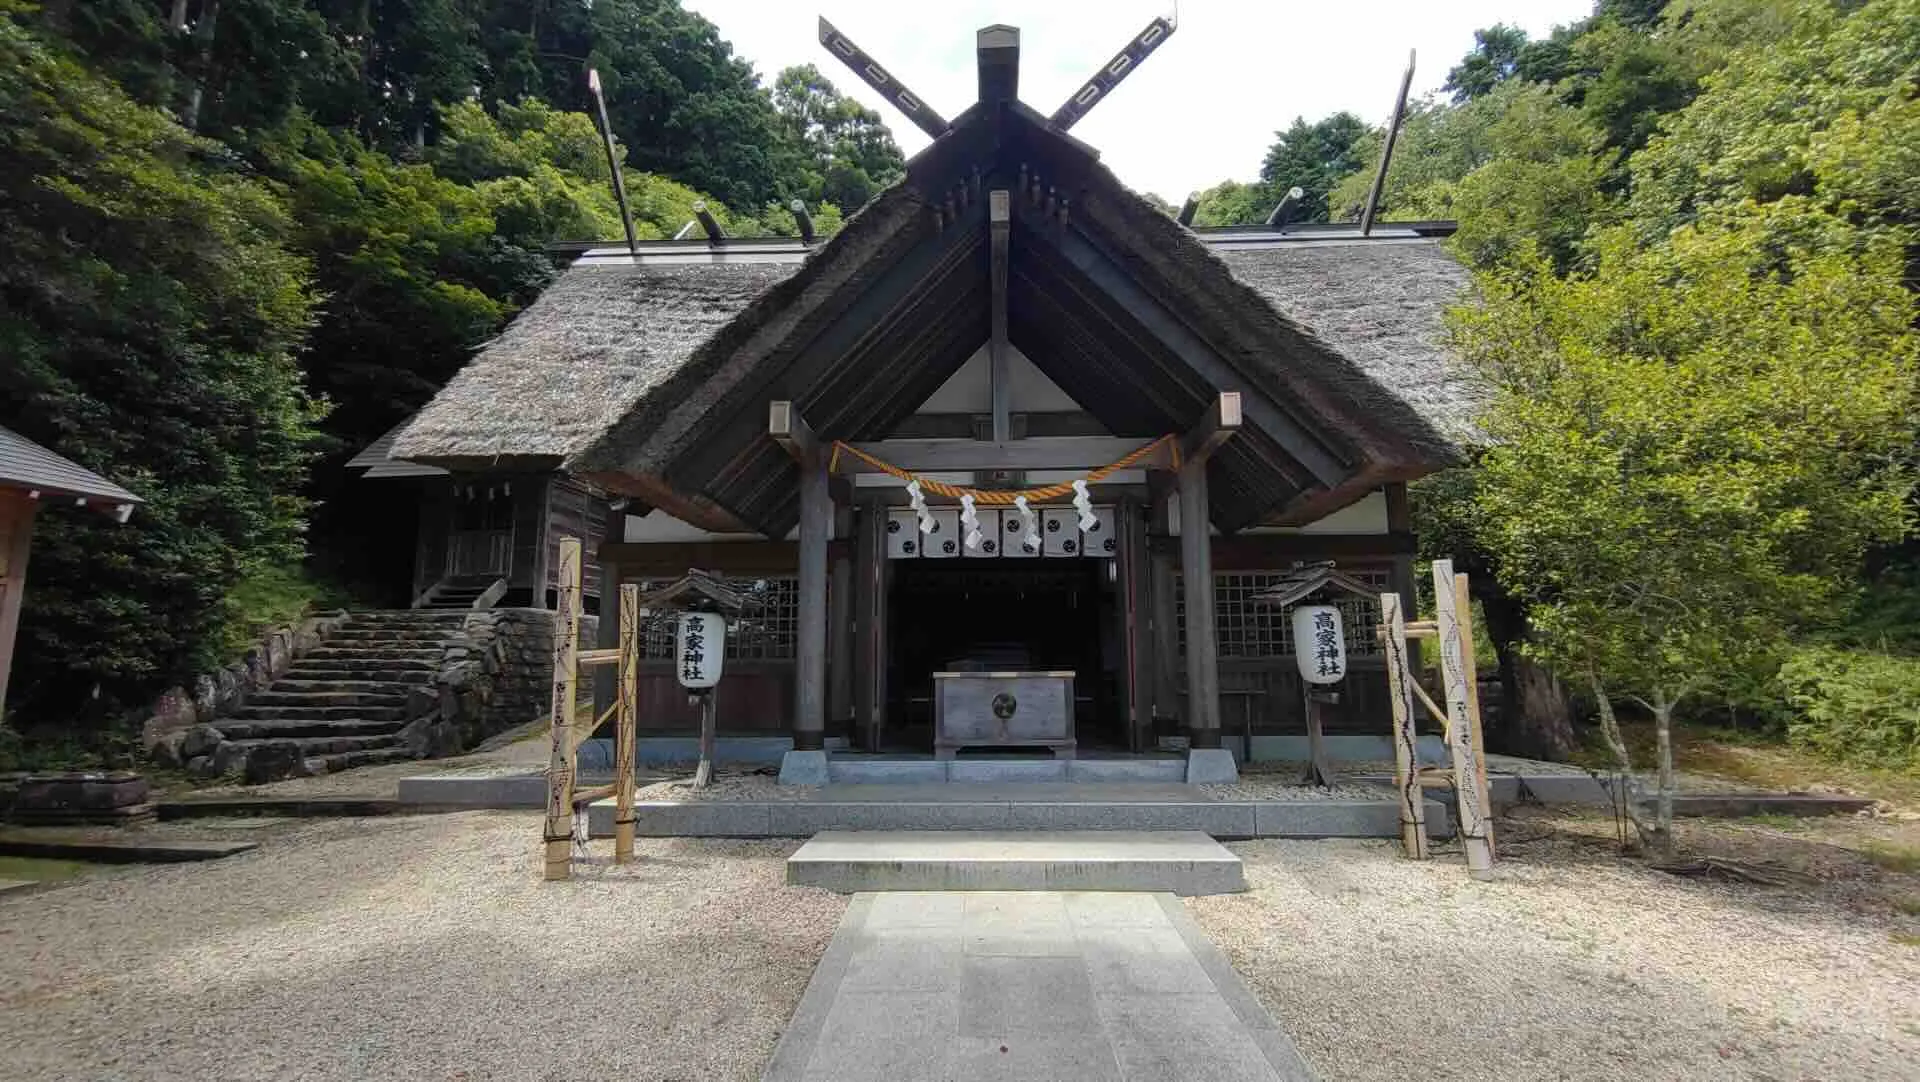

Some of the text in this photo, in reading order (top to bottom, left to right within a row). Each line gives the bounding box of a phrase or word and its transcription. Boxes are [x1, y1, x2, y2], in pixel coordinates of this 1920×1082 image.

[683, 616, 704, 680] 高家神社
[1313, 611, 1341, 676] 高家神社
